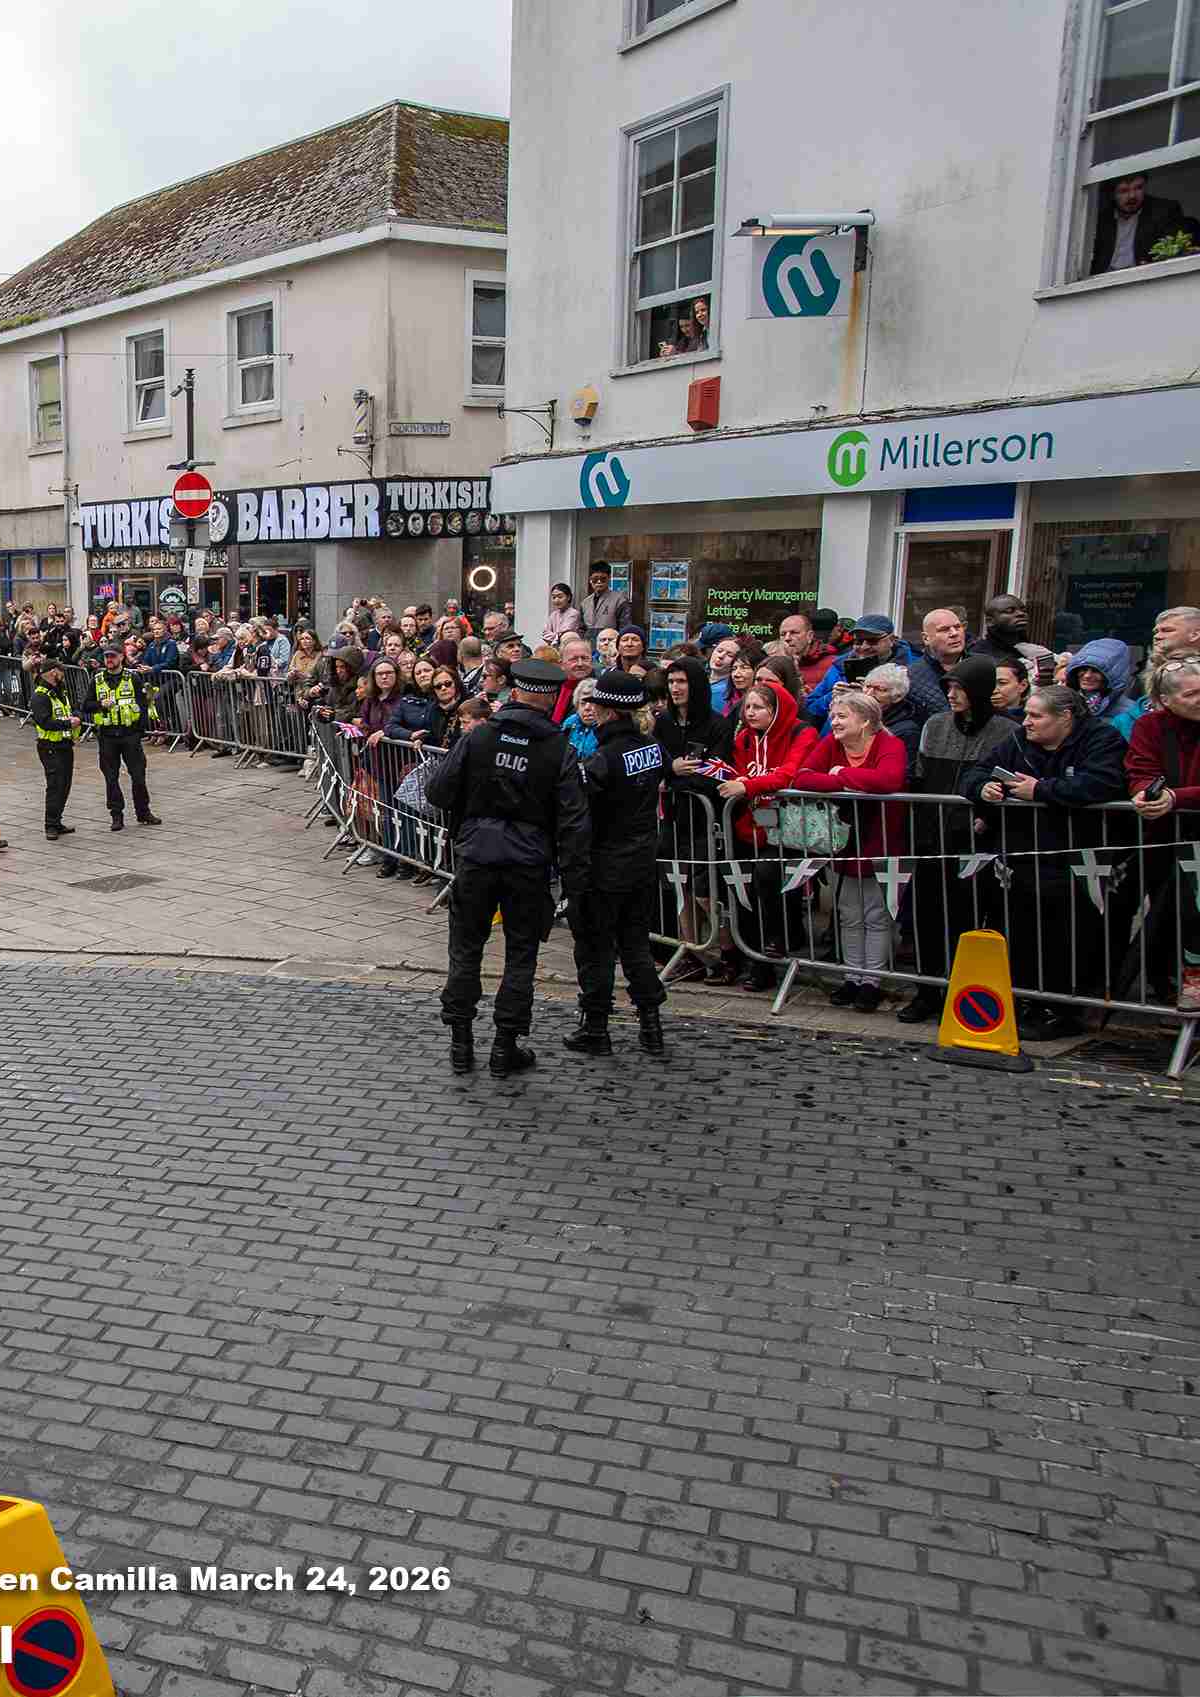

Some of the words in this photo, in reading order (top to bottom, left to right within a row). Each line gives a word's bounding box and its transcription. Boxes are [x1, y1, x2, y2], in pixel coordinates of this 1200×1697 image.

[879, 431, 1054, 471] Millerson
[386, 480, 489, 512] TURKISH
[80, 497, 174, 549] TURKIS
[237, 483, 381, 542] BARBER
[708, 588, 753, 603] Property
[755, 589, 817, 604] Manageme
[707, 604, 749, 619] Lettings
[495, 752, 529, 772] OLIC
[628, 747, 658, 772] POLICE
